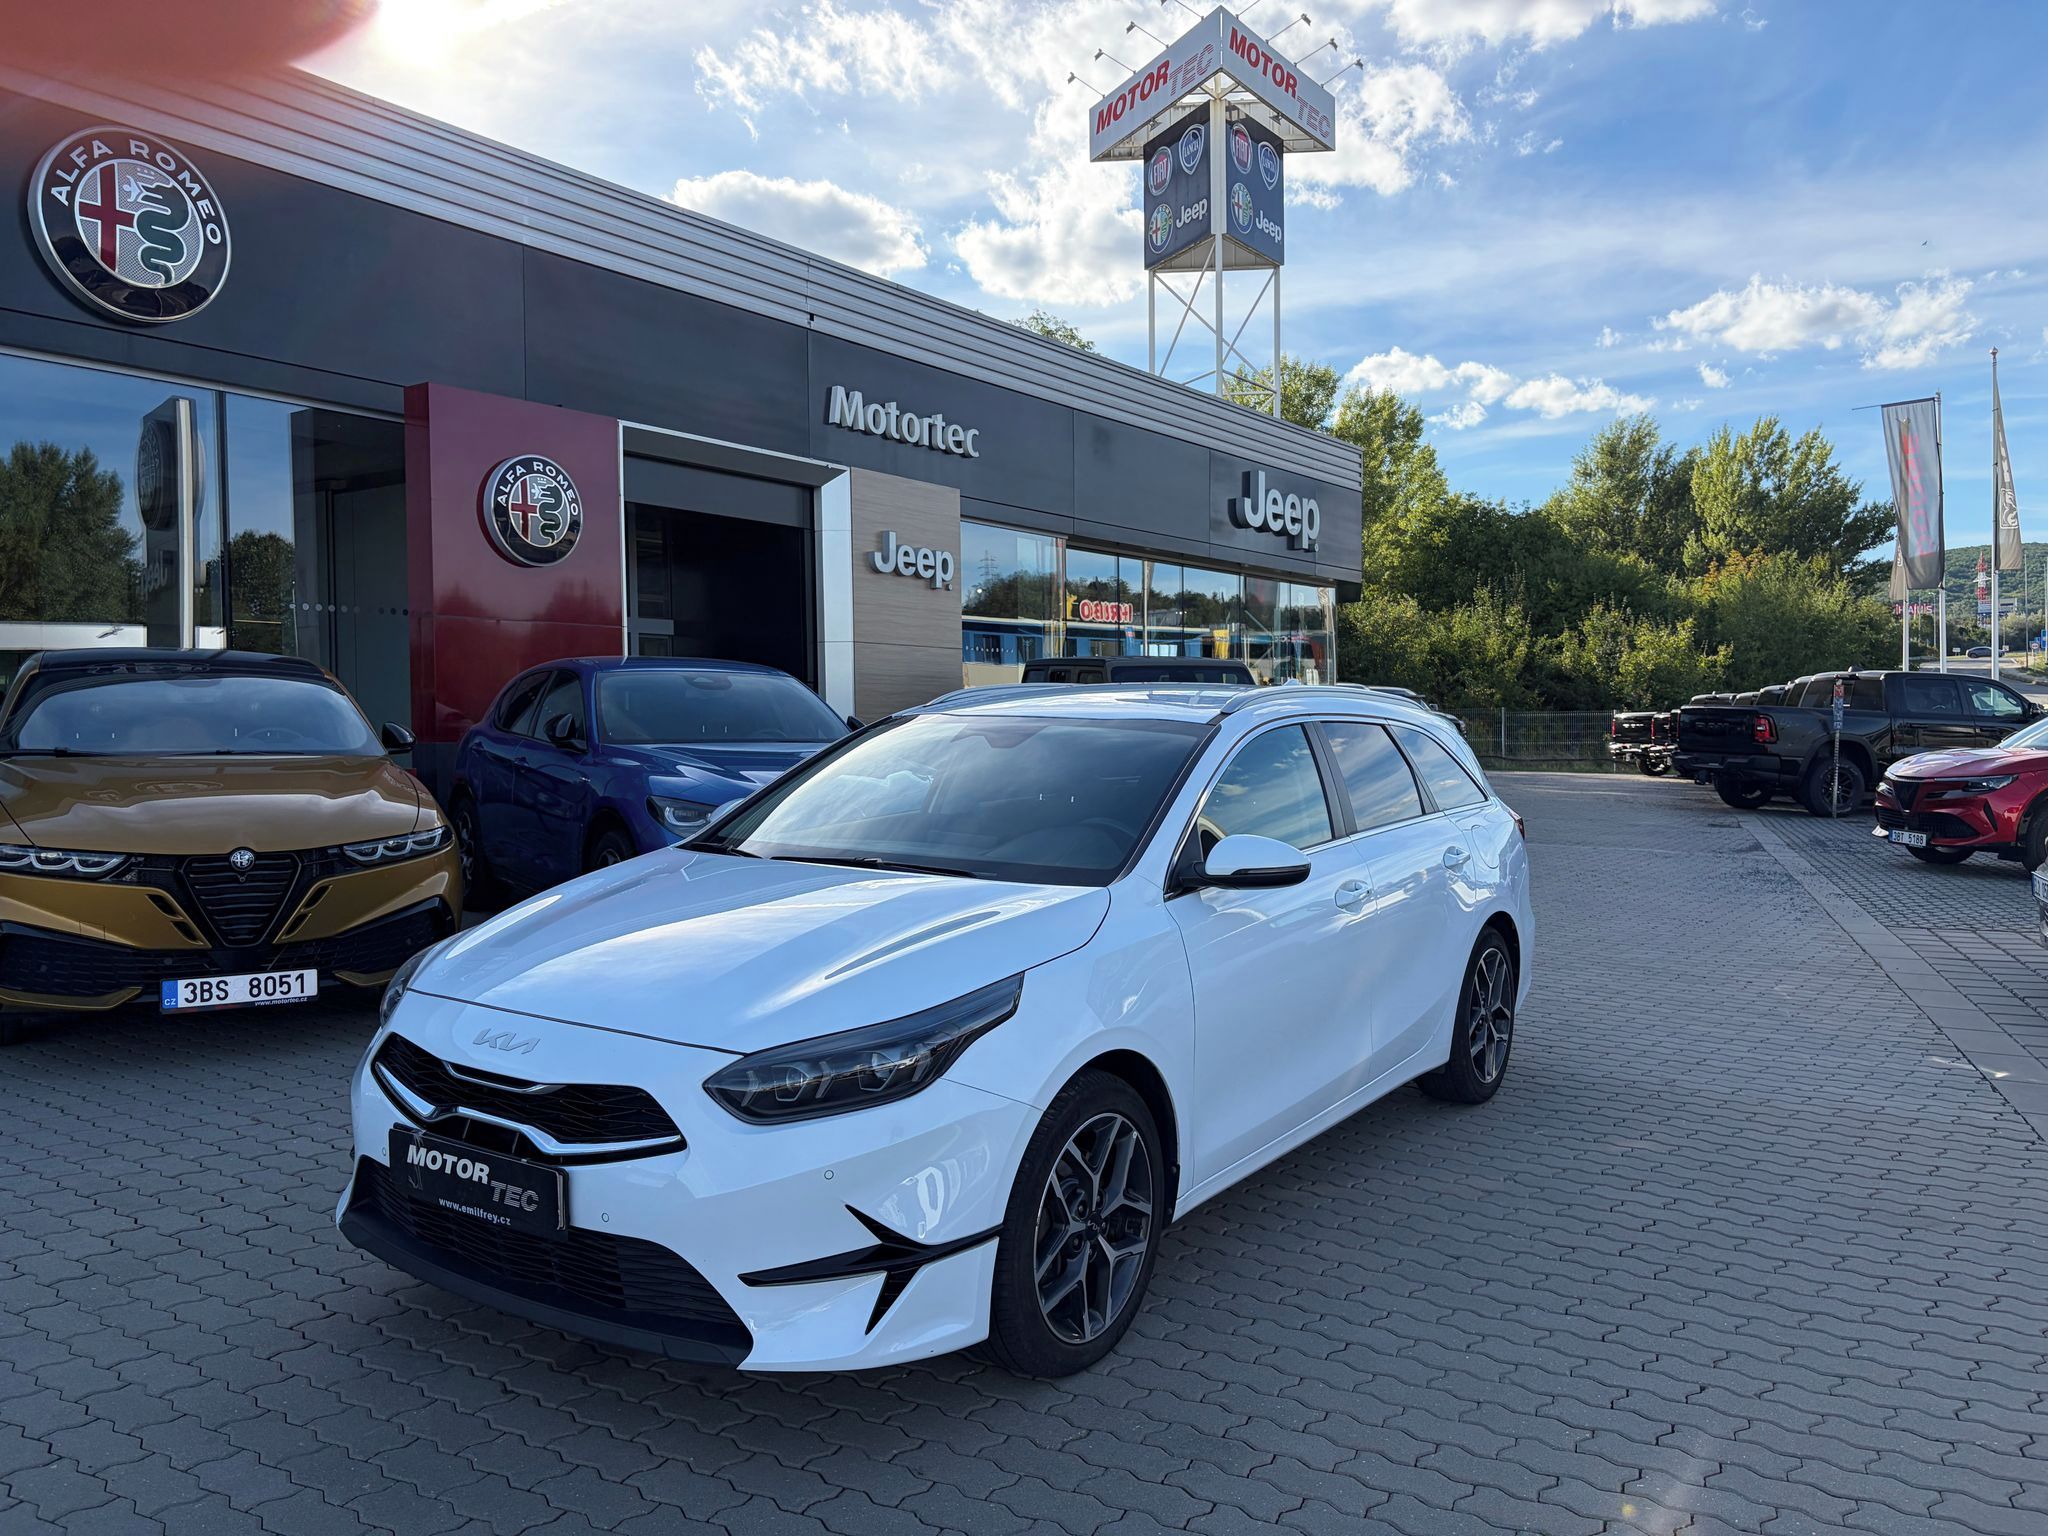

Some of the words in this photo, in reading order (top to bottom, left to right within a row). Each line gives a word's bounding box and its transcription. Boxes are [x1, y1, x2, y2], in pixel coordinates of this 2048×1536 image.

[1095, 59, 1170, 135] MOTOR
[1168, 43, 1214, 96] TEC
[1229, 27, 1297, 98] MOTOR
[1297, 95, 1331, 138] TEC
[51, 139, 113, 206] ALFA
[129, 139, 222, 245] ROMEO
[1153, 158, 1168, 185] FIAT
[1176, 198, 1207, 228] Jeep
[1255, 210, 1282, 243] Jeep
[829, 385, 980, 458] Motortec
[497, 465, 526, 506] ALFA
[533, 461, 579, 516] ROMEO
[1240, 470, 1320, 549] Jeep
[871, 530, 954, 589] Jeep
[164, 998, 176, 1006] CZ
[183, 979, 229, 1003] 3BS
[249, 972, 305, 998] 8051
[472, 1028, 541, 1055] KIA
[406, 1144, 490, 1185] MOTOR
[490, 1180, 539, 1212] TEC
[438, 1197, 511, 1226] www.emilfrey.cz
